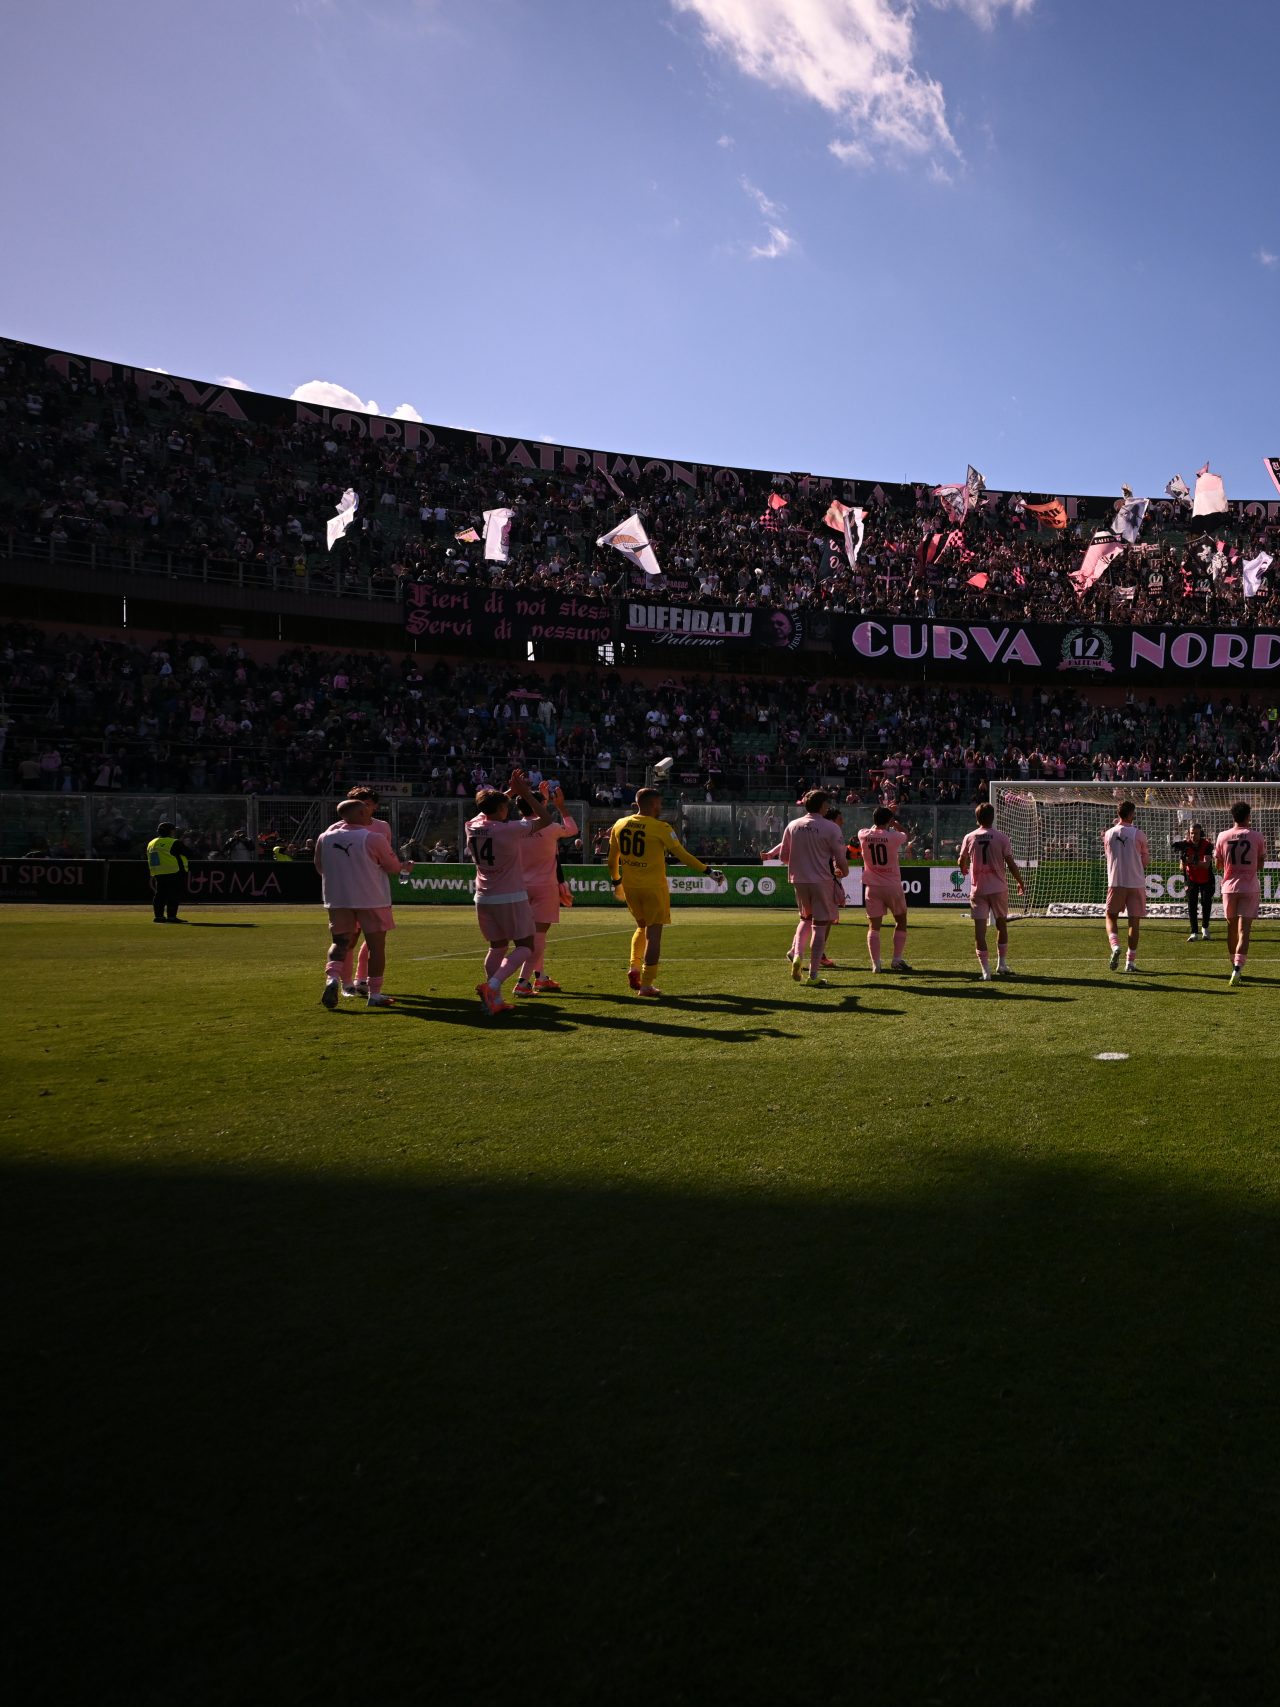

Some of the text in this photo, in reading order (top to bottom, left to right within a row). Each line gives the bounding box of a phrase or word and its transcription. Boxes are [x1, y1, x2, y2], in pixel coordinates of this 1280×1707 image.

[476, 434, 739, 489] PATRIMONO
[484, 590, 505, 615] di
[516, 594, 546, 617] noi
[406, 609, 611, 641] Servi di nessuno
[628, 604, 753, 635] DIFFIDATI
[650, 631, 725, 649] Palermo
[852, 621, 1042, 667] CURVA
[1072, 637, 1100, 657] 12
[468, 836, 495, 866] 14
[620, 828, 646, 857] 66
[867, 843, 888, 866] 10
[978, 841, 990, 864] 7
[1227, 840, 1252, 865] 72
[18, 864, 85, 886] SPOSI
[672, 878, 704, 890] Segui
[1050, 905, 1106, 915] GoldBe
